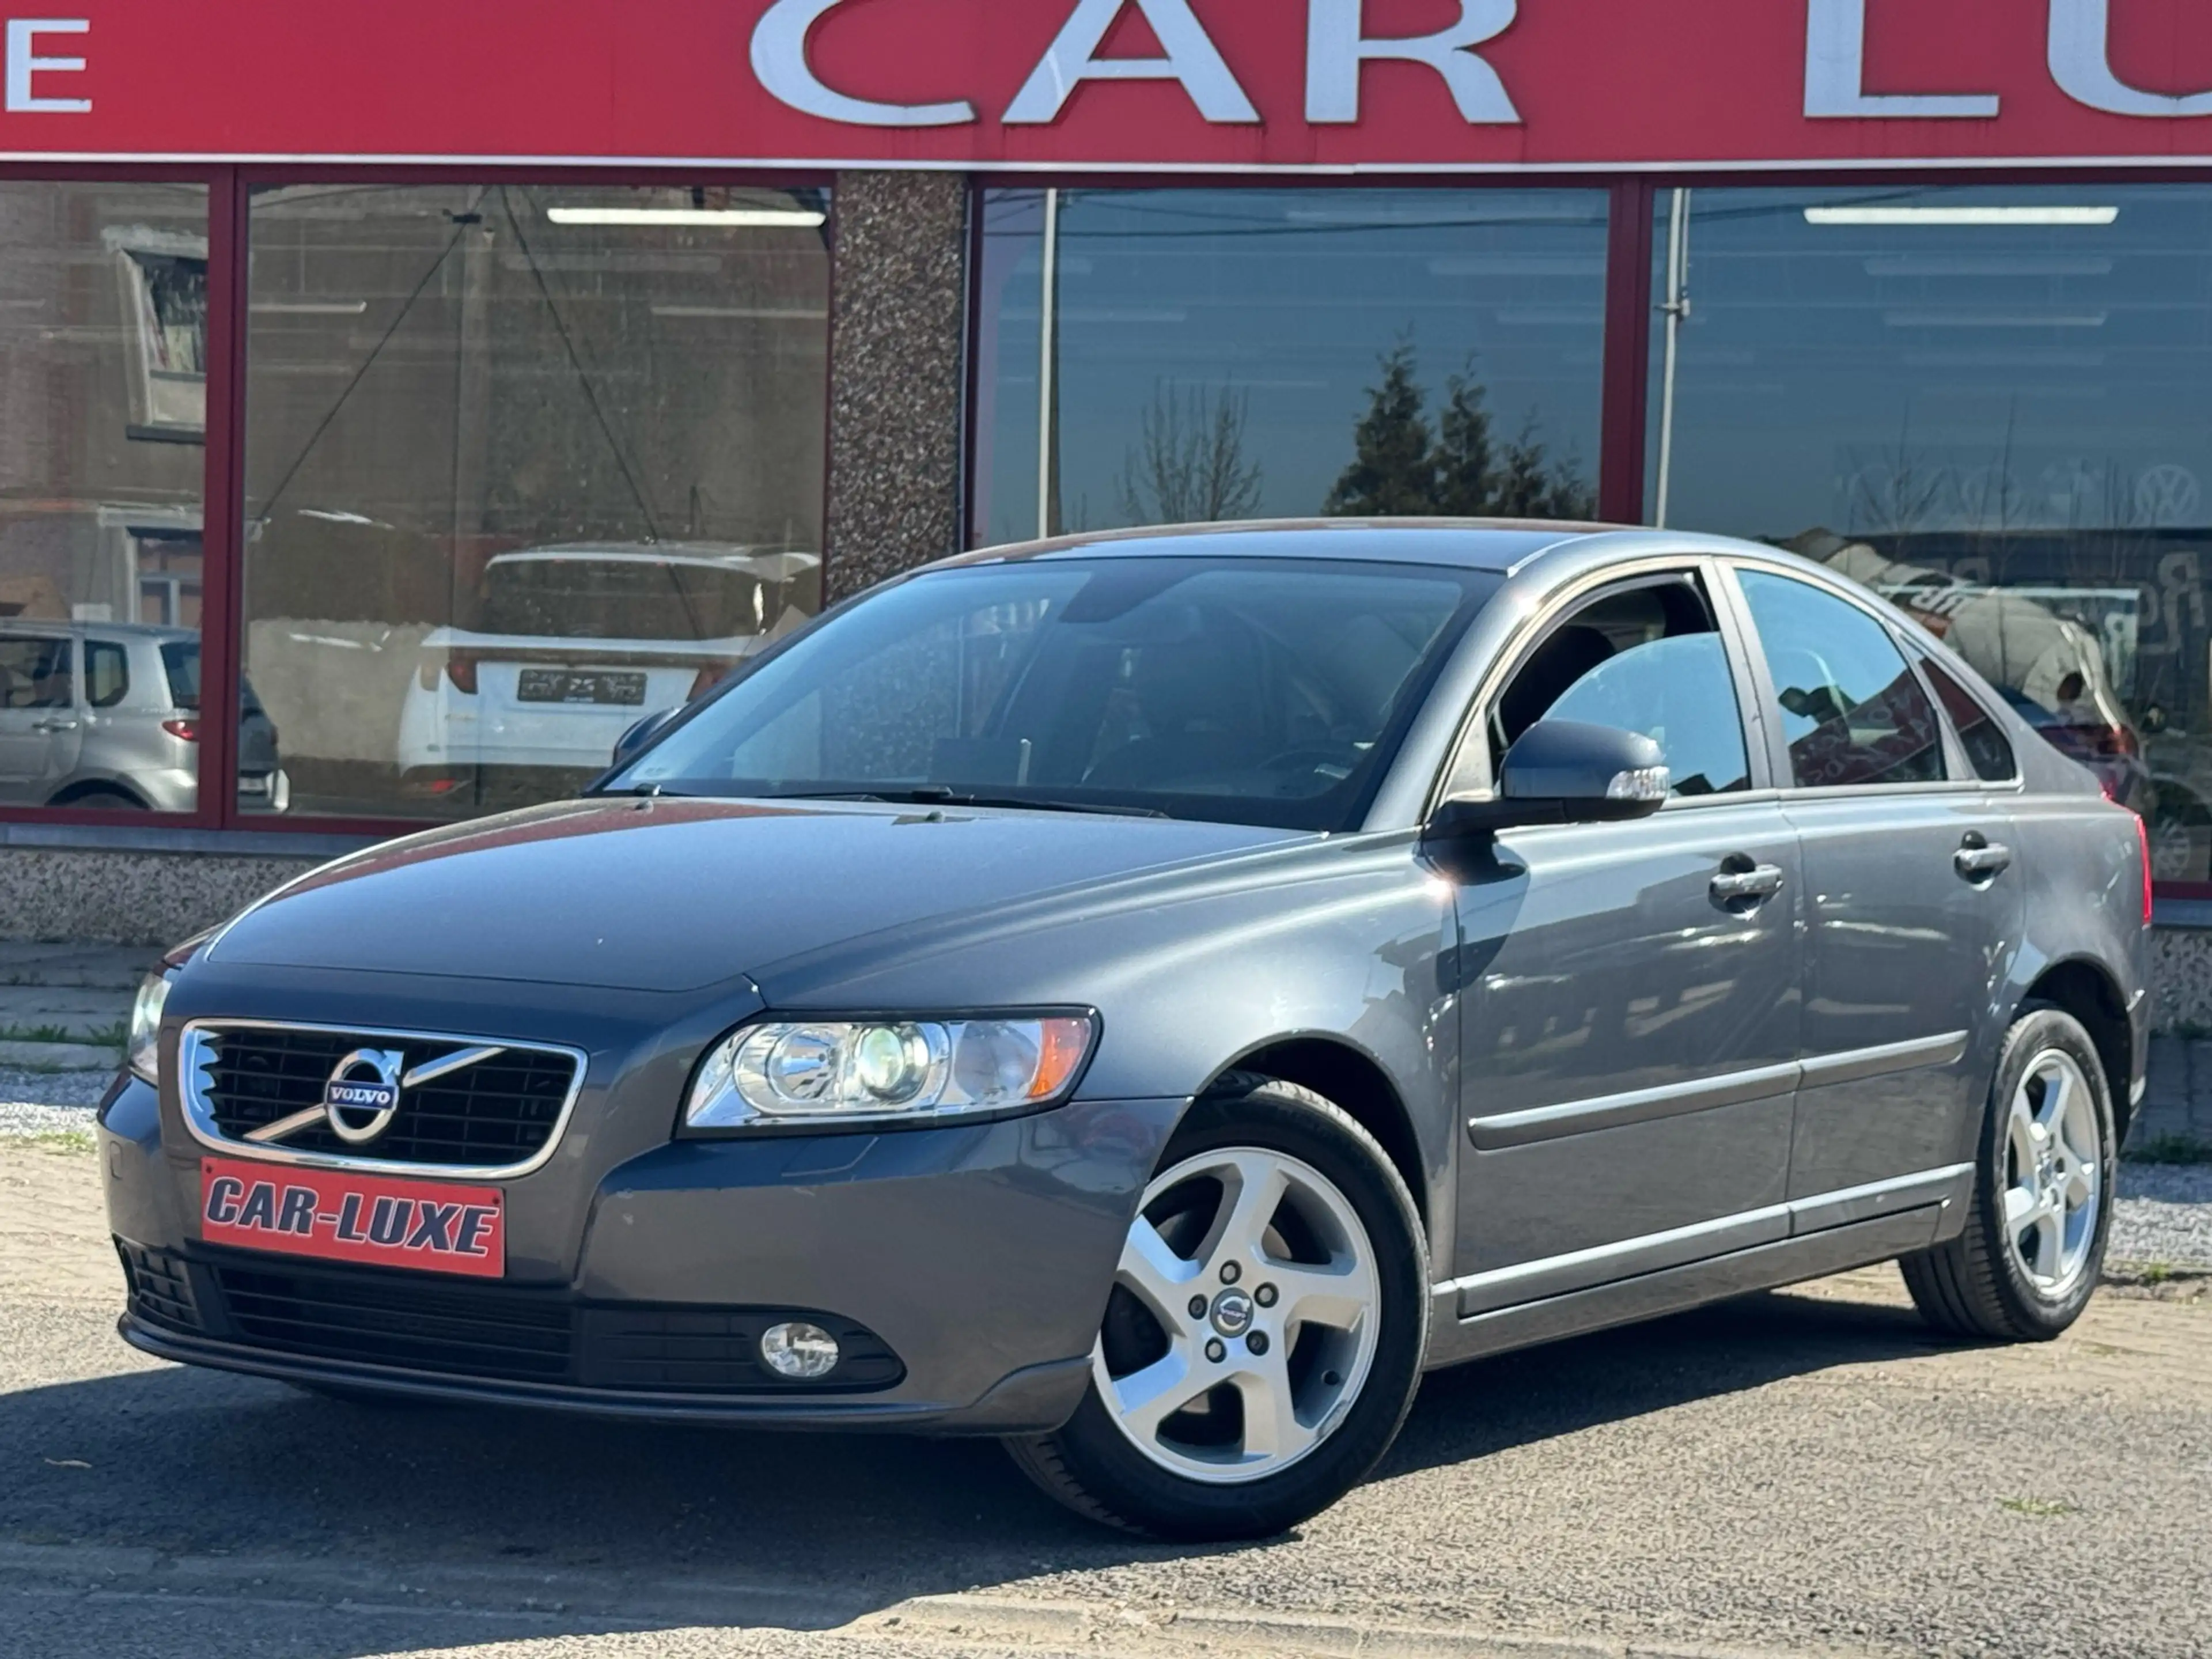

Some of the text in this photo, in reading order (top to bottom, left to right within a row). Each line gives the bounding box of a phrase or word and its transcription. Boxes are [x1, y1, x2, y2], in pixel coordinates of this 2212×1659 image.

[5, 18, 93, 112] E
[750, 0, 1521, 126] CAR
[330, 1086, 391, 1105] VOLVO
[206, 1176, 499, 1257] CAR-LUXE
